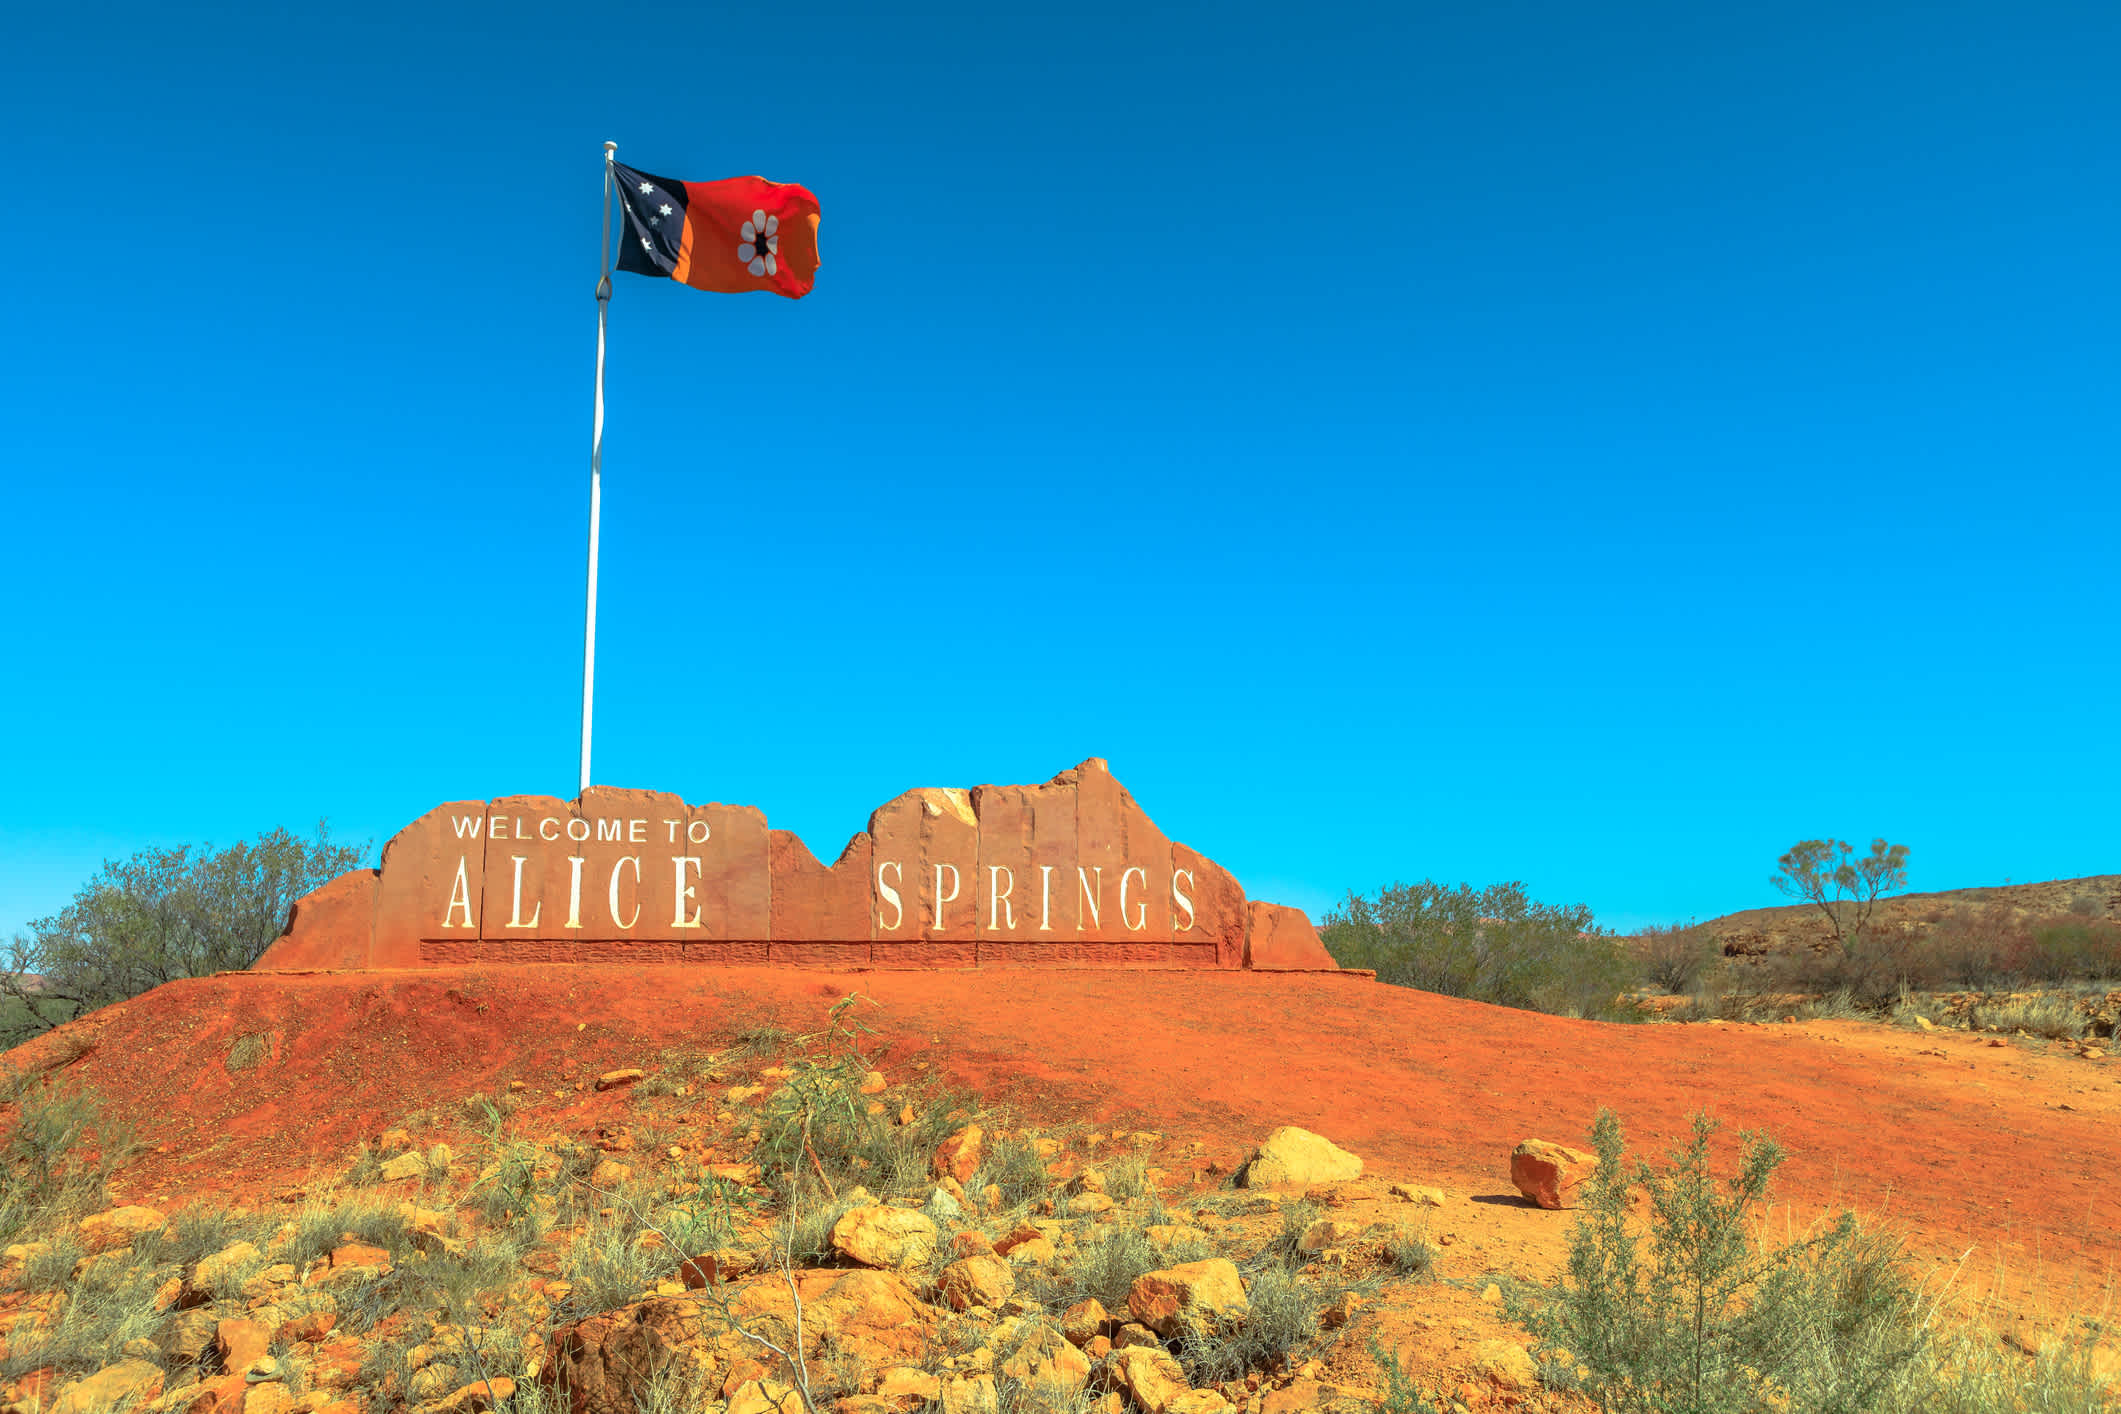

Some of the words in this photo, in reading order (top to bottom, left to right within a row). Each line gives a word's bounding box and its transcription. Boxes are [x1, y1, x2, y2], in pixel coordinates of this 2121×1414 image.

[451, 815, 648, 842] WELCOME
[663, 819, 711, 843] TO
[443, 855, 702, 929] ALICE
[878, 861, 1195, 931] SPRINGS
